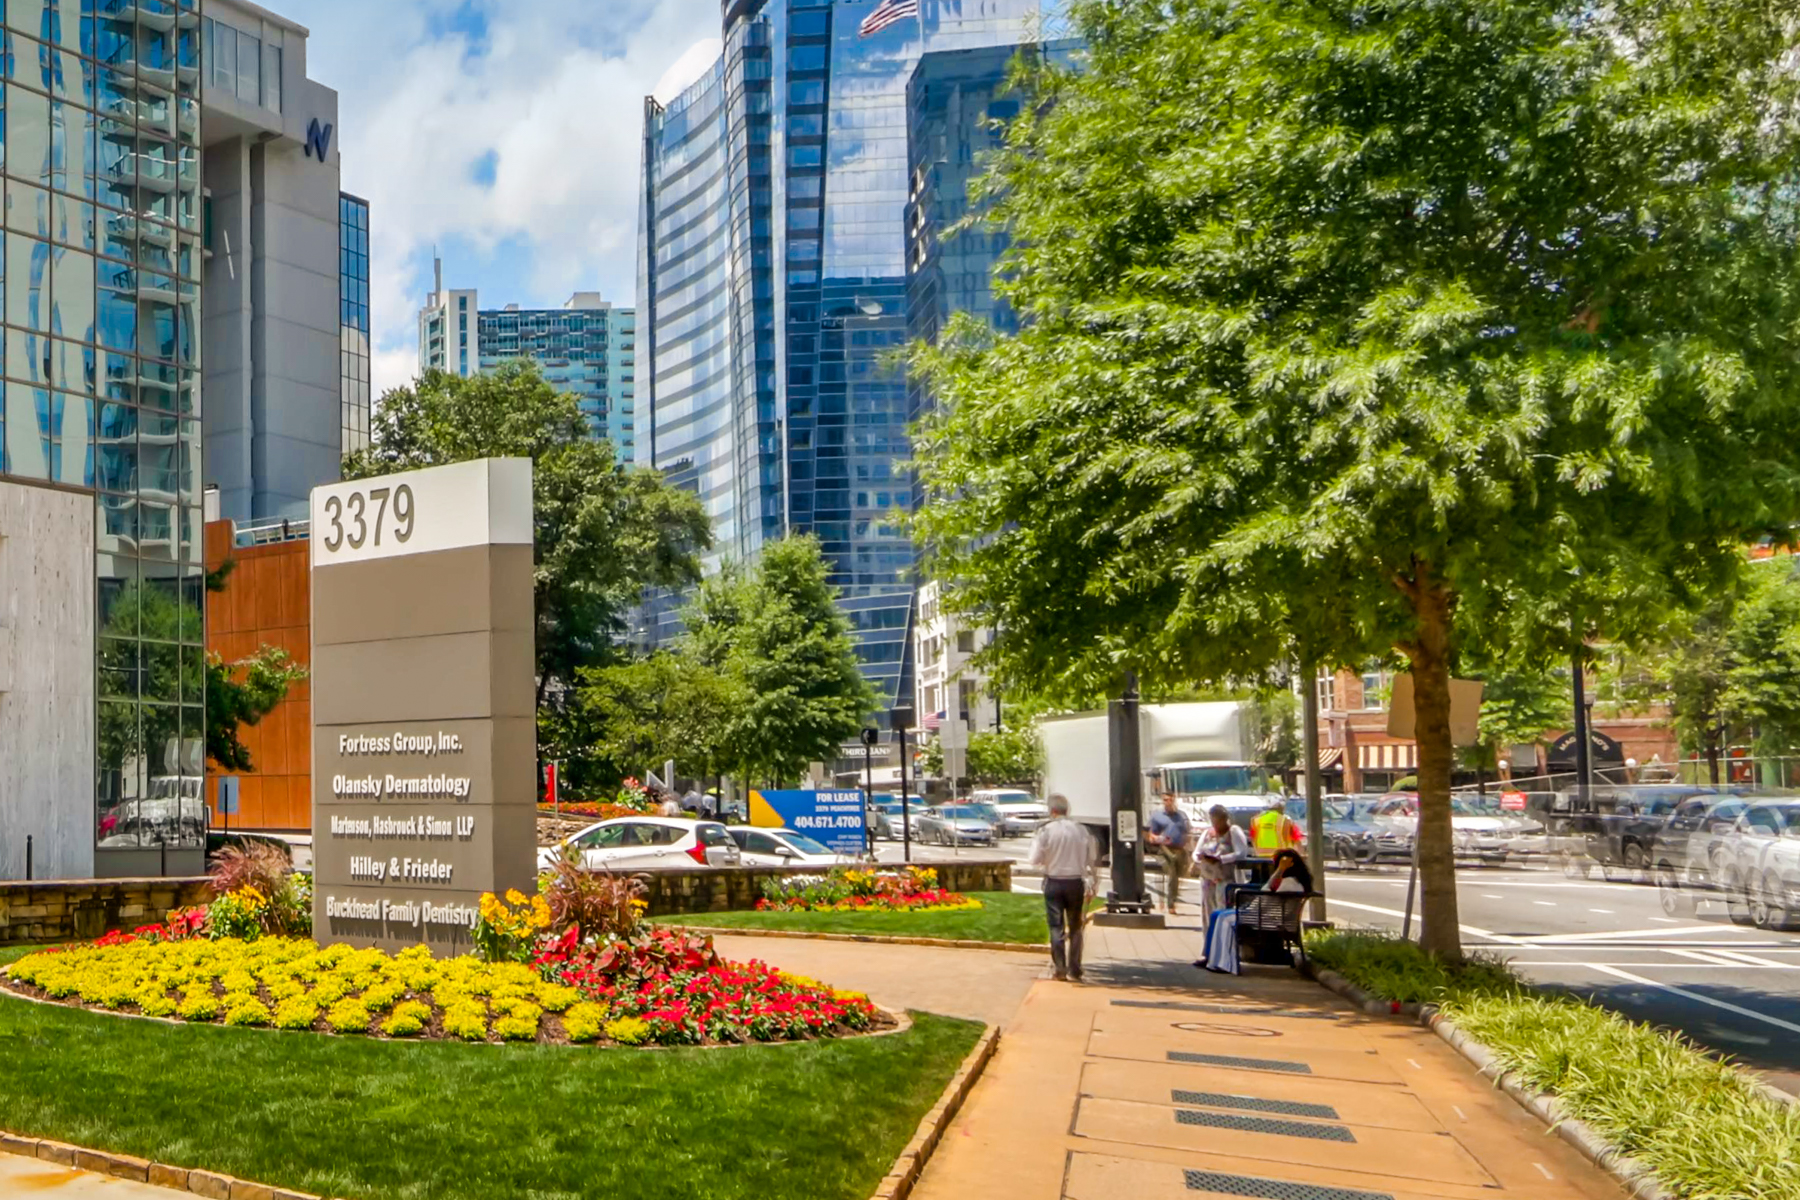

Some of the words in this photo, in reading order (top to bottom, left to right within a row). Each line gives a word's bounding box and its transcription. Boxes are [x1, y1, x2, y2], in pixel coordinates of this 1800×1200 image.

[324, 483, 415, 553] 3379
[339, 734, 391, 753] Fortress
[393, 731, 437, 755] Group,
[438, 730, 463, 750] Inc.
[841, 747, 867, 756] THIRD
[332, 774, 383, 797] Olansky
[385, 774, 470, 797] Dermatology
[816, 793, 833, 802] FOR
[834, 793, 860, 802] LEASE
[331, 815, 372, 838] Martenson,
[373, 815, 416, 836] Hasbrouck
[417, 816, 425, 836] &
[426, 815, 452, 836] Simon
[456, 816, 474, 836] LLP
[794, 816, 861, 828] 404.671.4700
[350, 856, 386, 879] Hilley
[389, 857, 400, 877] &
[403, 857, 453, 879] Frieder
[326, 896, 381, 920] Buckhead
[382, 899, 421, 928] Family
[422, 901, 478, 930] Dentistry
